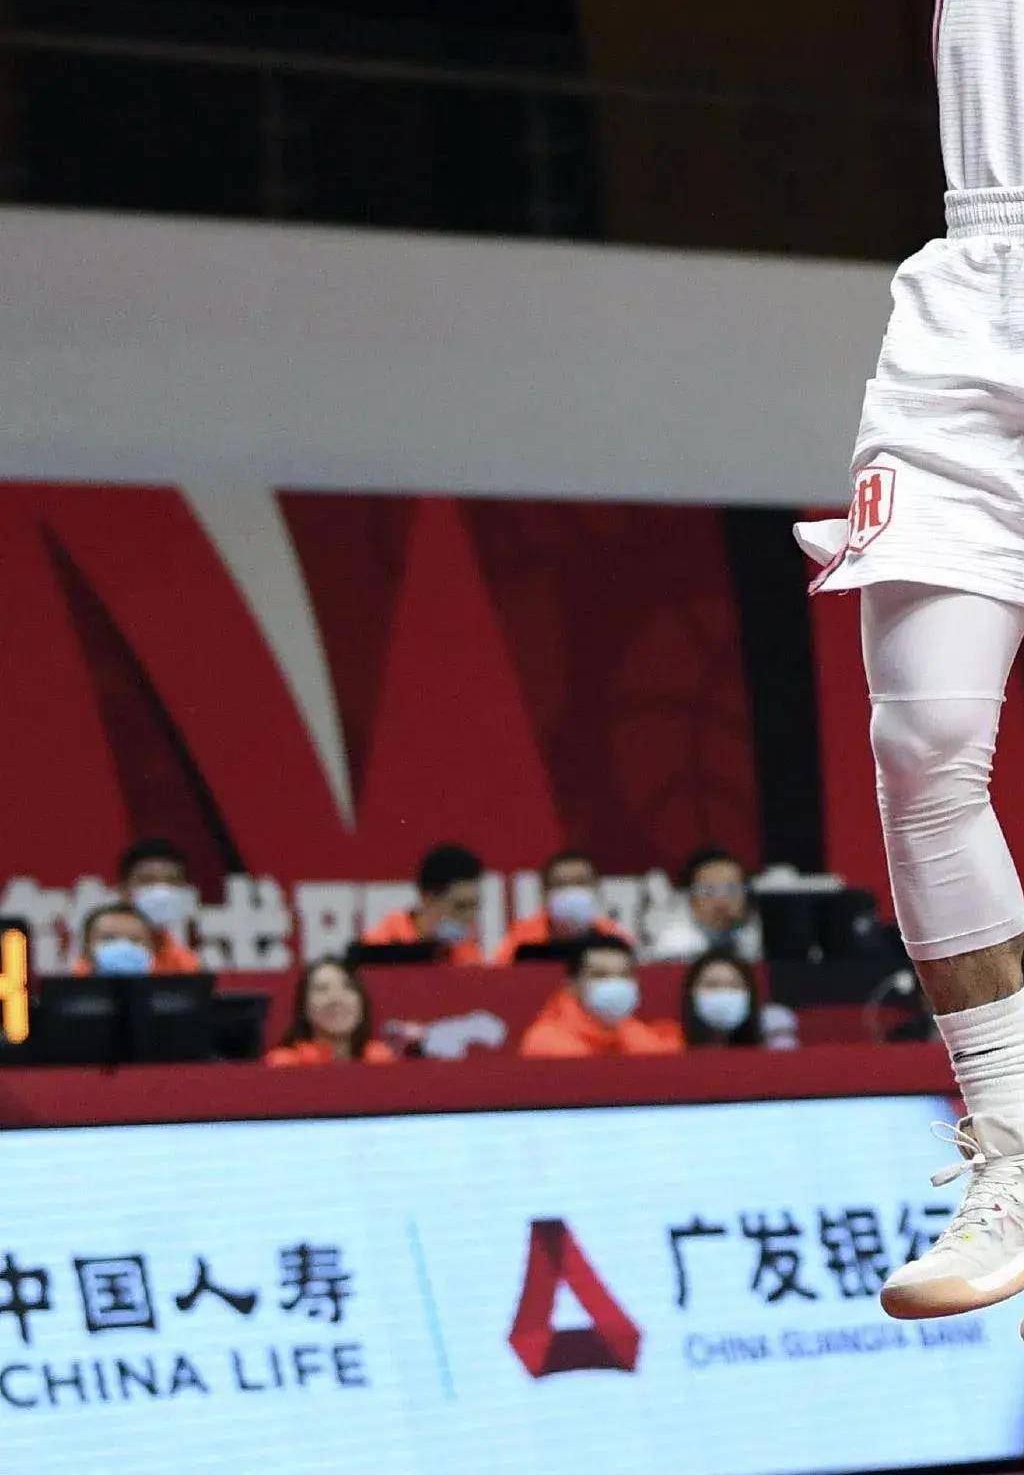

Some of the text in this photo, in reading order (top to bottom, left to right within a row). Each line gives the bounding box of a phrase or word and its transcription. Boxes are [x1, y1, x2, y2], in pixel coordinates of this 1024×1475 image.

[0, 1243, 352, 1347] 中国人寿
[0, 1340, 368, 1408] CHINA LIFE
